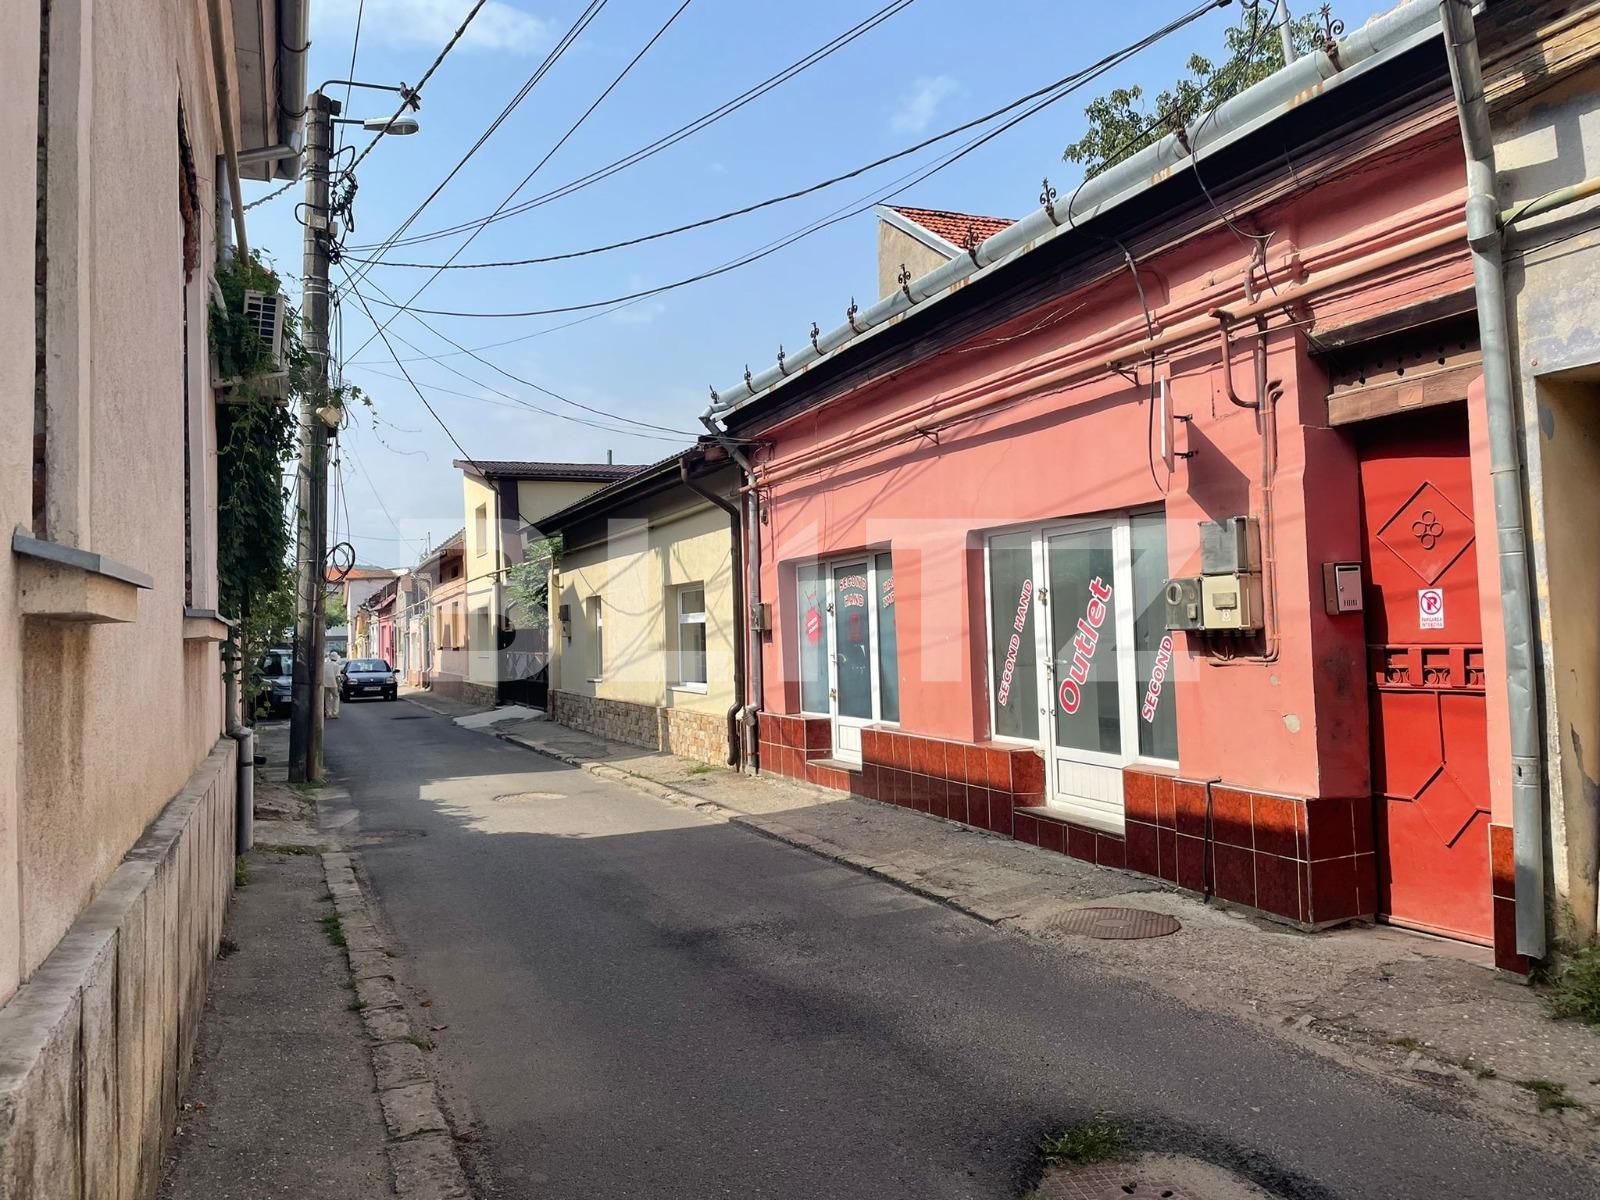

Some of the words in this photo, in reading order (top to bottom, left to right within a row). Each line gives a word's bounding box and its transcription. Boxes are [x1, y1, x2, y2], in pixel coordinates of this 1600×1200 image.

[839, 575, 867, 592] SECOND
[843, 593, 865, 608] HAND
[998, 633, 1020, 706] SECOND
[1013, 578, 1033, 632] HAND
[1059, 576, 1113, 715] Outlet
[1141, 635, 1174, 723] SECOND
